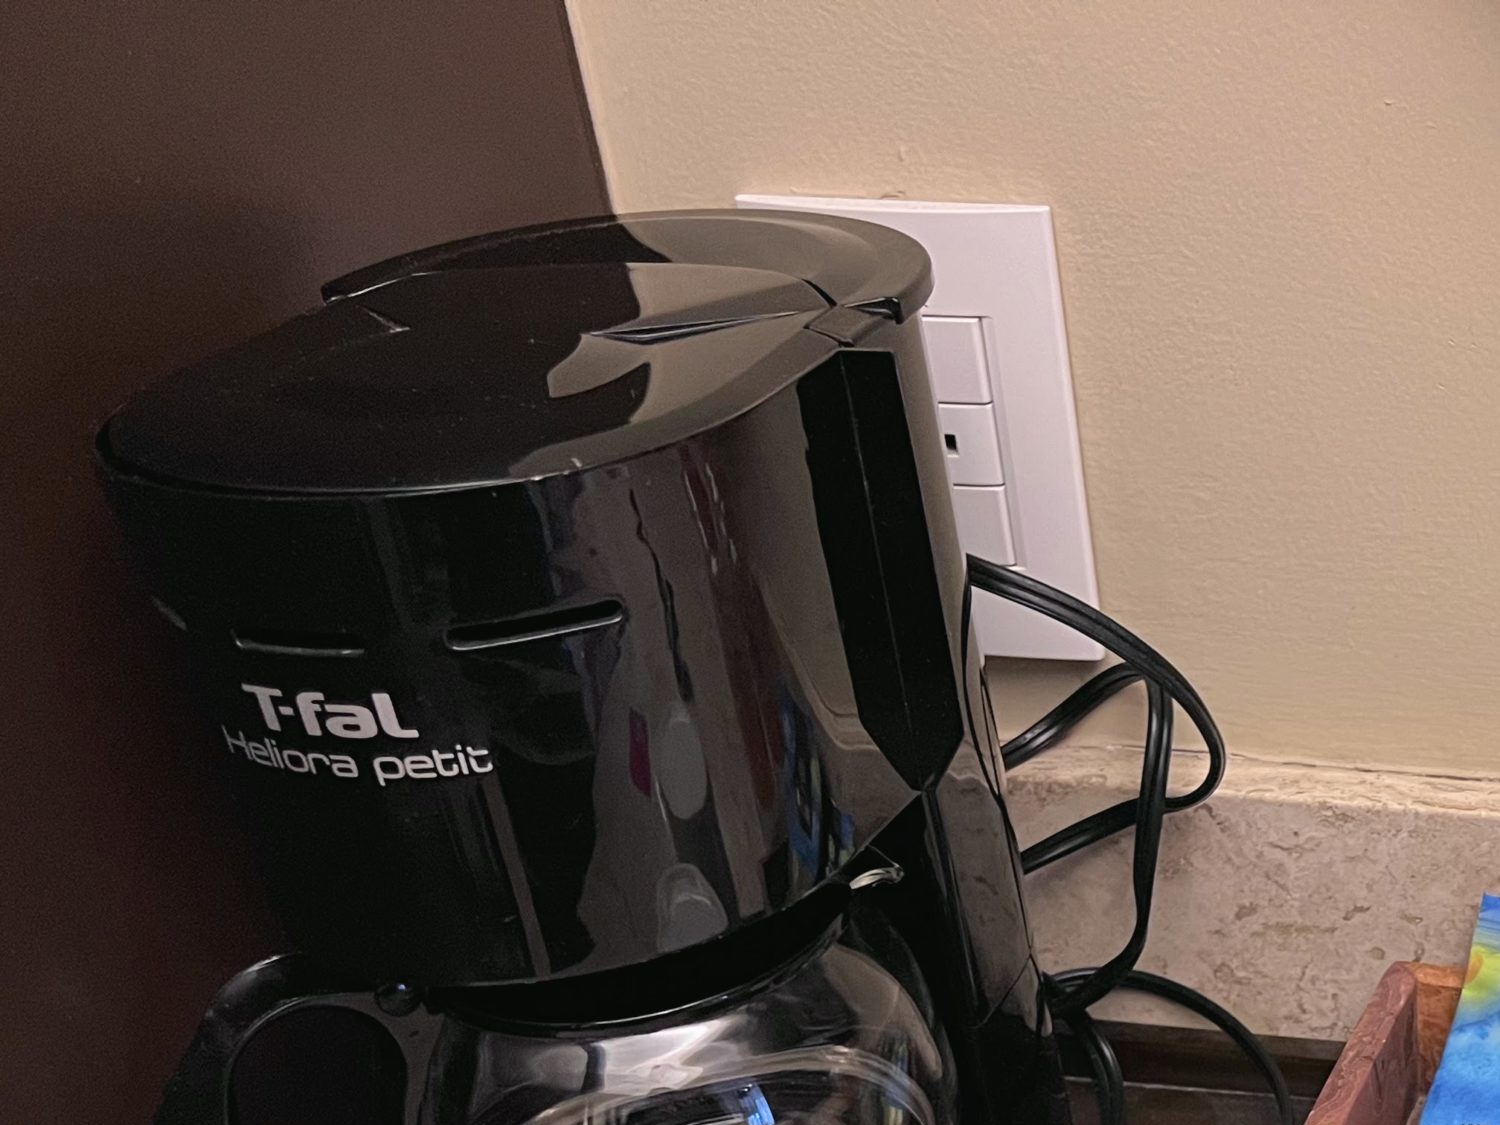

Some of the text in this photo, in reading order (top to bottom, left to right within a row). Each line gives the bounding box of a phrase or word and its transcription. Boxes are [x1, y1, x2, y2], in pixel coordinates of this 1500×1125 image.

[241, 683, 419, 738] T-fal
[221, 724, 493, 786] Heliora petit
